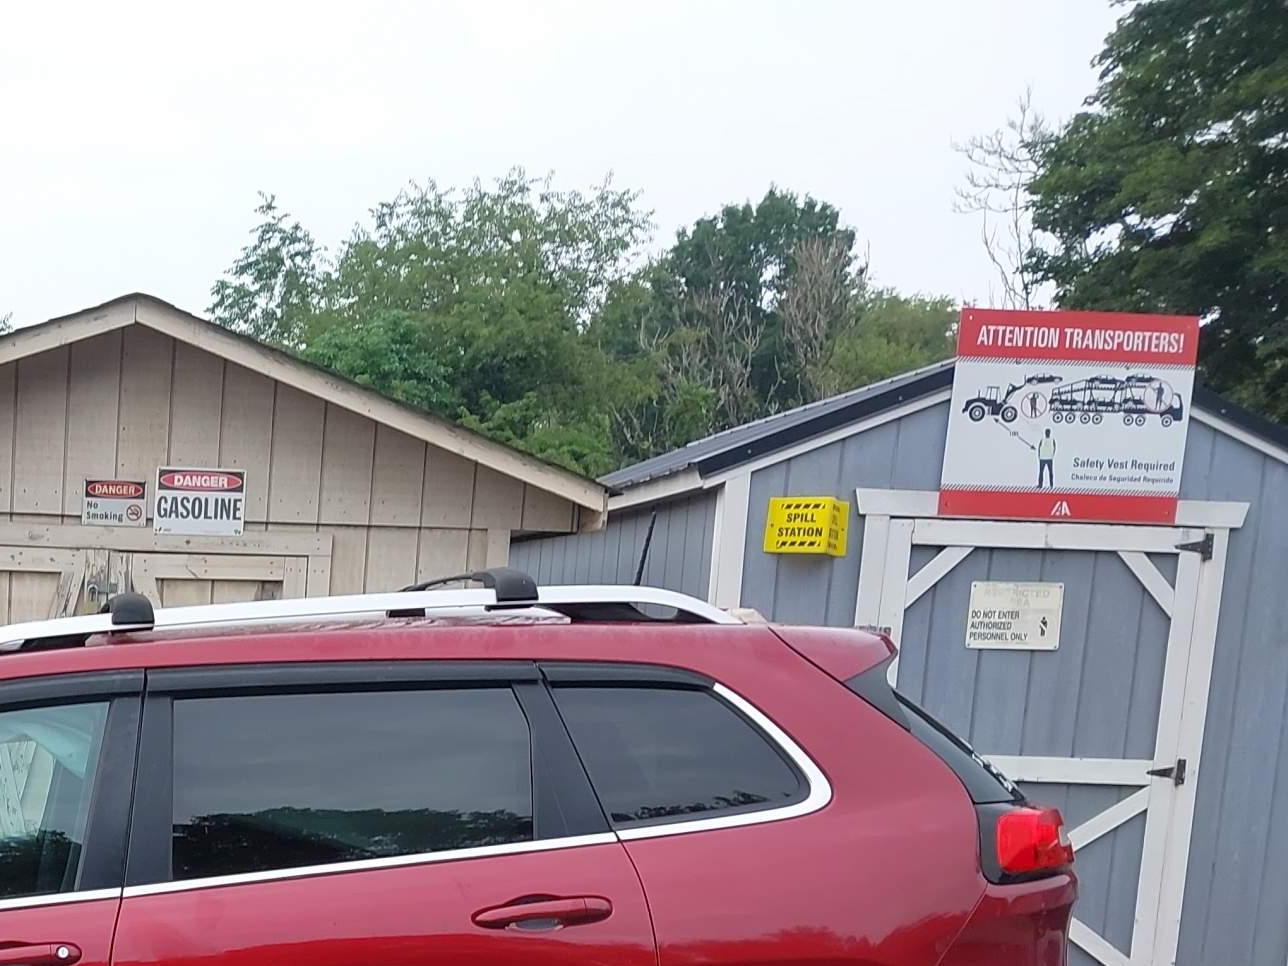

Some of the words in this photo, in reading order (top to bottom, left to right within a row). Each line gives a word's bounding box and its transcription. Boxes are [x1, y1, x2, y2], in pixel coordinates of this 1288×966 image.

[977, 325, 1060, 348] ATTENTION
[1064, 328, 1185, 353] TRANSPORTERS!
[1073, 457, 1105, 470] Safety
[1107, 459, 1128, 469] Vest
[1131, 460, 1175, 472] Required
[174, 475, 228, 488] DANGER
[95, 484, 136, 495] DANGER
[86, 501, 98, 509] No
[157, 496, 242, 520] GASOLINE
[86, 511, 123, 523] Smoking
[786, 512, 817, 523] SPILL
[777, 527, 823, 537] STATION
[971, 610, 981, 619] DO
[982, 610, 996, 619] NOT
[998, 611, 1020, 620] ENTER
[970, 621, 1012, 630] AUTHORIZED
[969, 632, 1009, 641] PERSONNEL
[1010, 633, 1028, 641] ONLY
